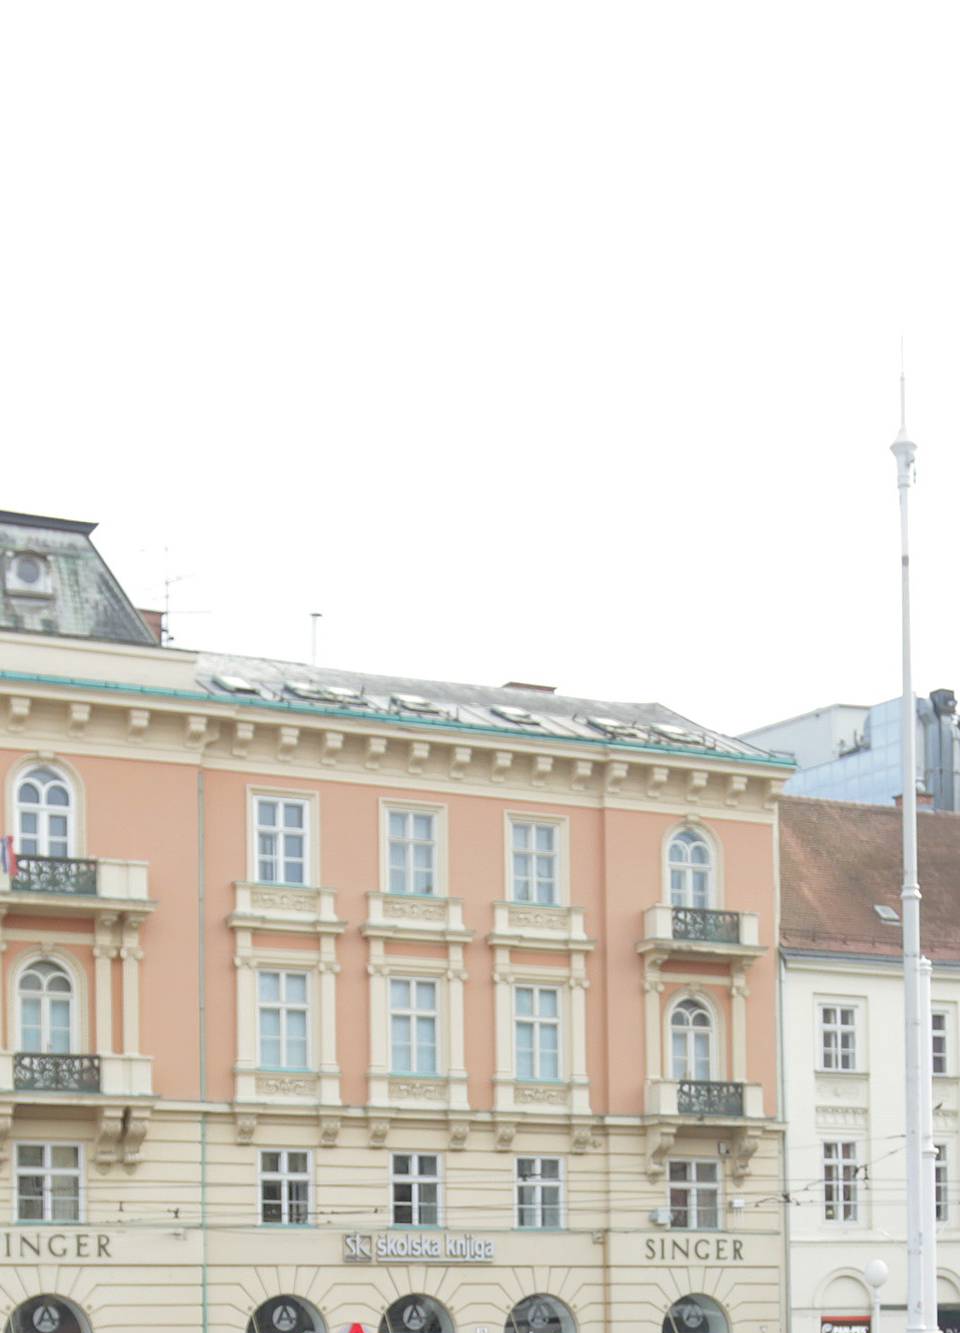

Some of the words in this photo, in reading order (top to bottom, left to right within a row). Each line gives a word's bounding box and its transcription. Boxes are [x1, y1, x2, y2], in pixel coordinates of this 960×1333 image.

[4, 1232, 112, 1257] INGER
[377, 1233, 440, 1257] školska
[445, 1232, 496, 1259] knjiga
[645, 1238, 744, 1261] SINGER
